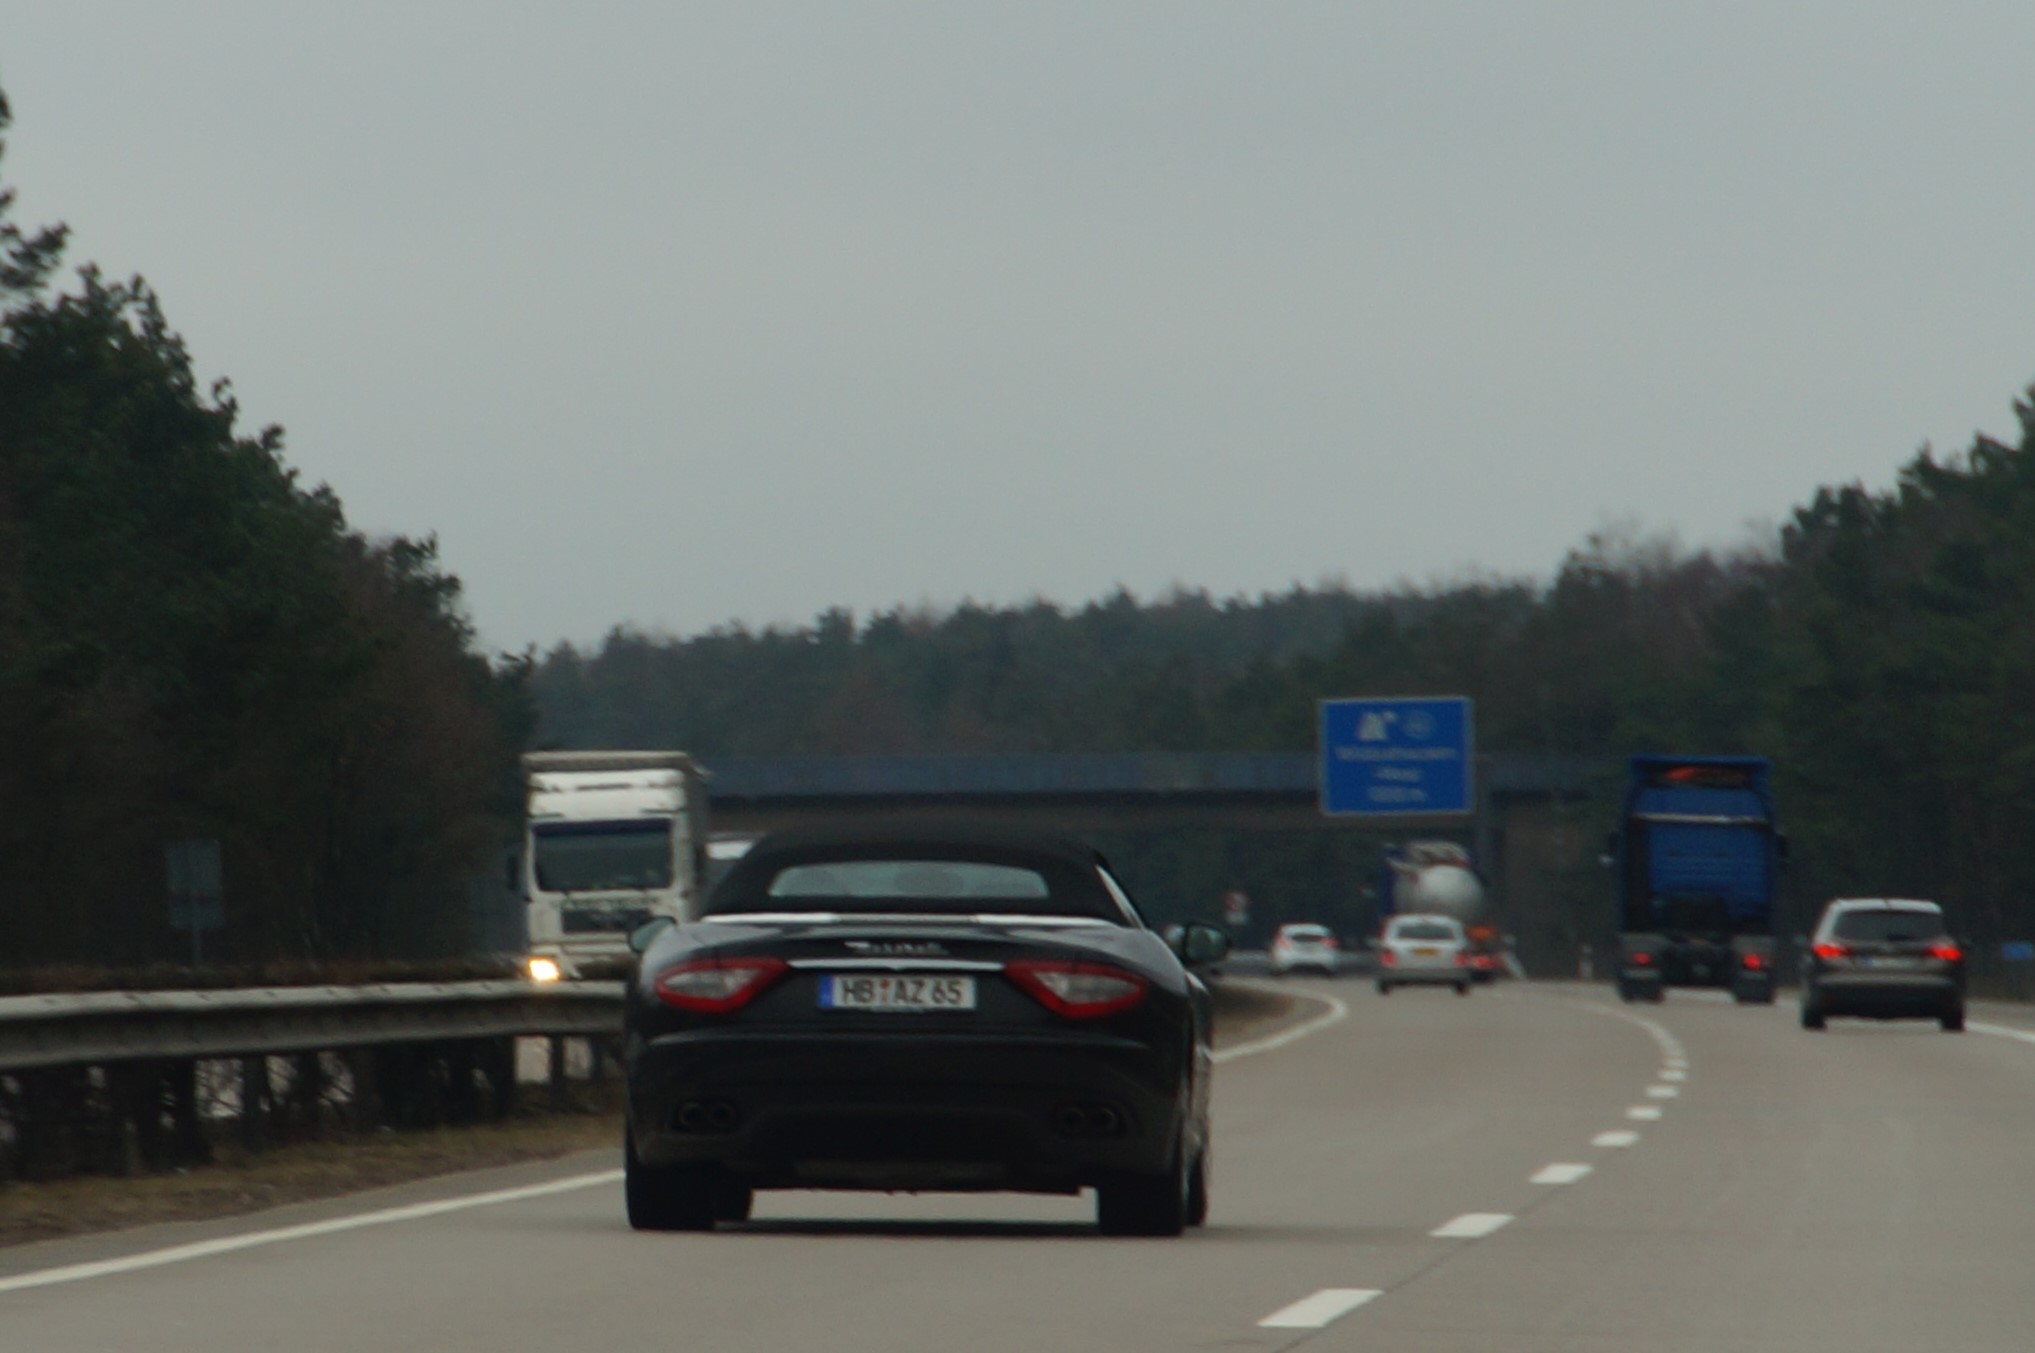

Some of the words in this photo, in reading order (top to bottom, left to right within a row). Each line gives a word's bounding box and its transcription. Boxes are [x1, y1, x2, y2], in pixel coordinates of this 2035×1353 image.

[842, 979, 874, 1004] HB
[894, 979, 925, 1004] AZ
[931, 979, 962, 1004] 65
